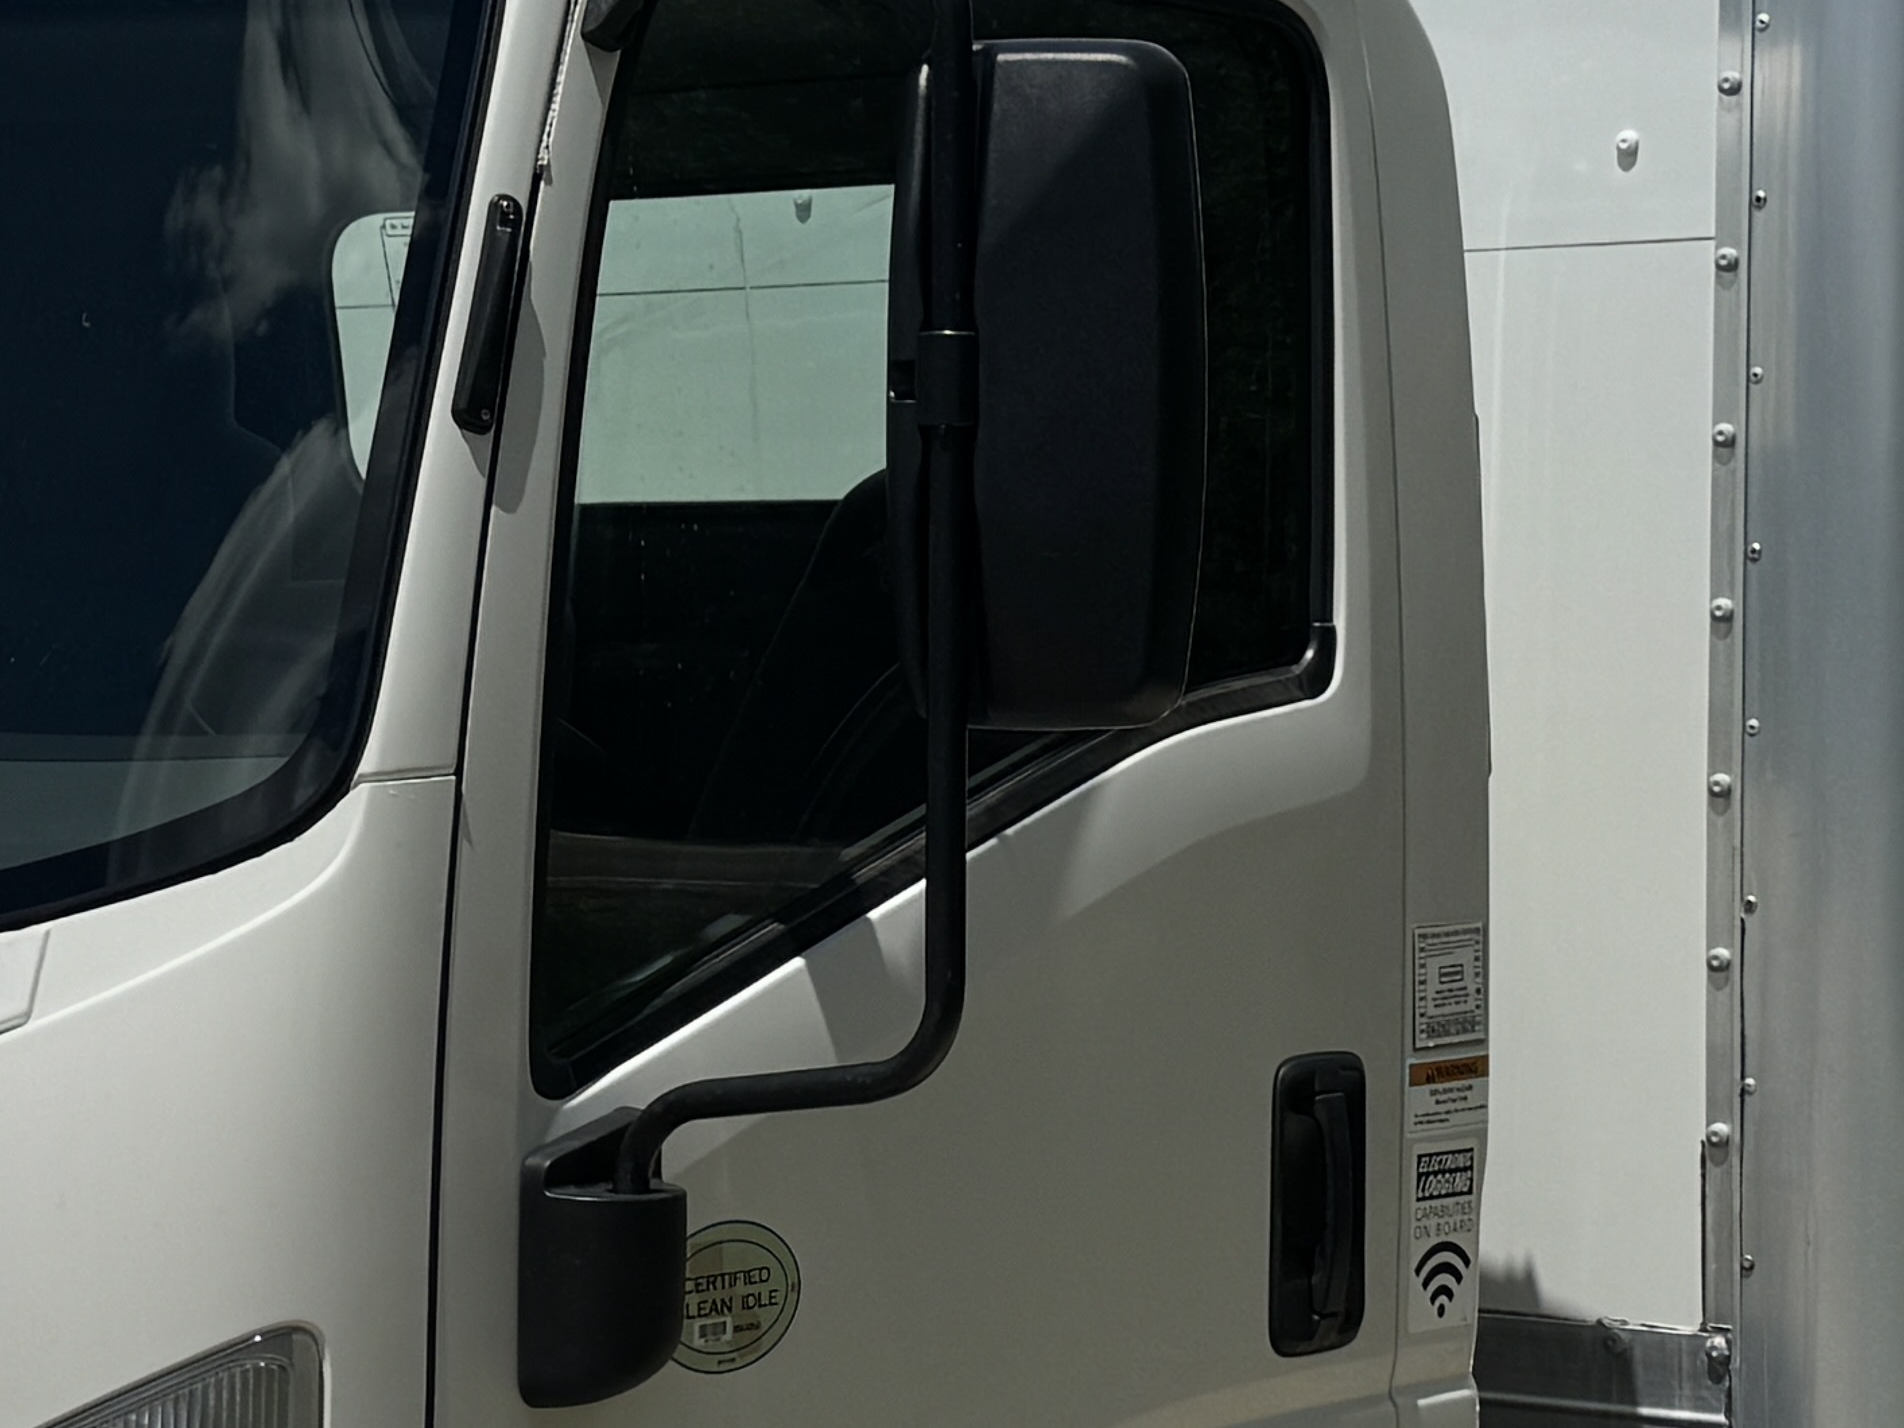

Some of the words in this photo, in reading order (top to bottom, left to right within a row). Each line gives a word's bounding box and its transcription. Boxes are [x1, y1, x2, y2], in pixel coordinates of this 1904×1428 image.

[1417, 1171, 1471, 1198] LOGGING
[684, 1296, 733, 1320] LEAN
[742, 1289, 780, 1310] IDLE
